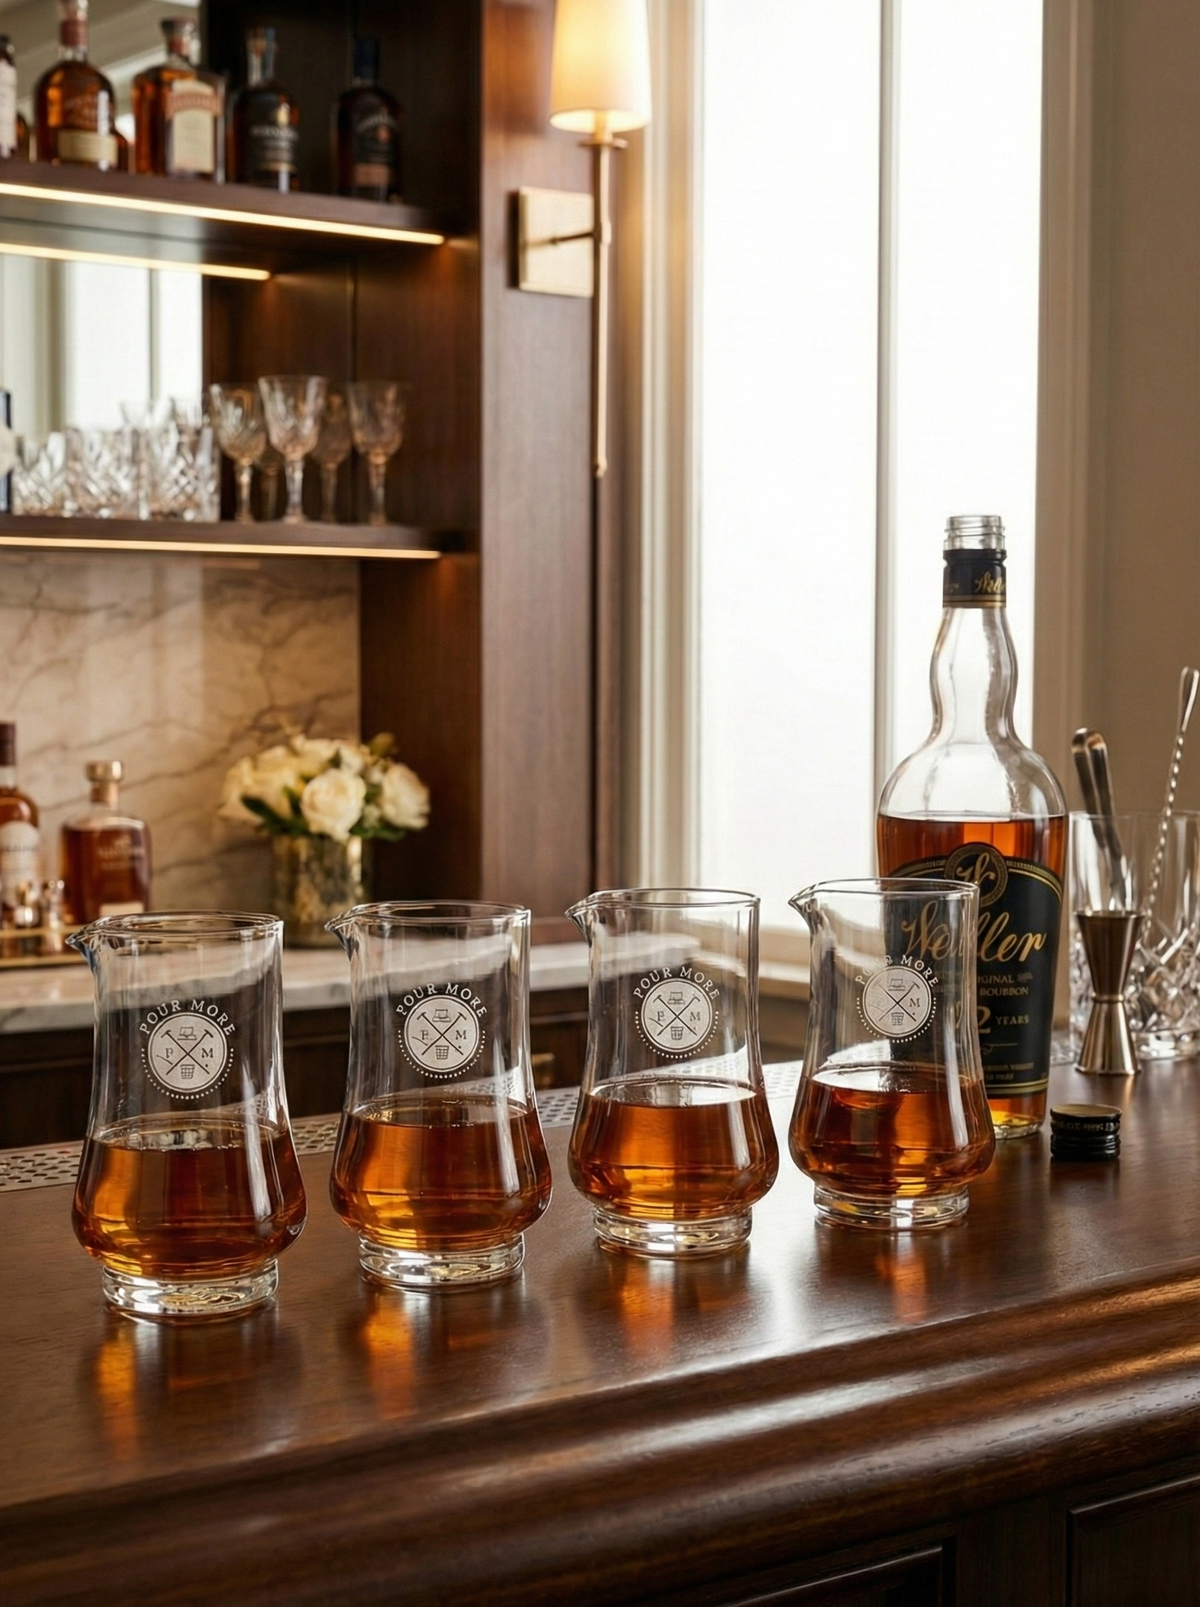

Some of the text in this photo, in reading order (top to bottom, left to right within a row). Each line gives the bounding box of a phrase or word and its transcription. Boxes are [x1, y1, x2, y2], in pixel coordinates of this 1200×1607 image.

[900, 900, 1047, 963] Weller
[900, 954, 939, 988] MORE
[633, 966, 720, 1000] POUR MORE
[979, 986, 1029, 996] BOURBON
[396, 982, 488, 1018] POUR MORE
[909, 997, 921, 1008] M
[139, 999, 236, 1036] POUR MORE
[689, 1011, 701, 1022] M
[995, 1014, 1030, 1025] YEARS
[455, 1029, 467, 1041] M
[201, 1047, 214, 1059] M
